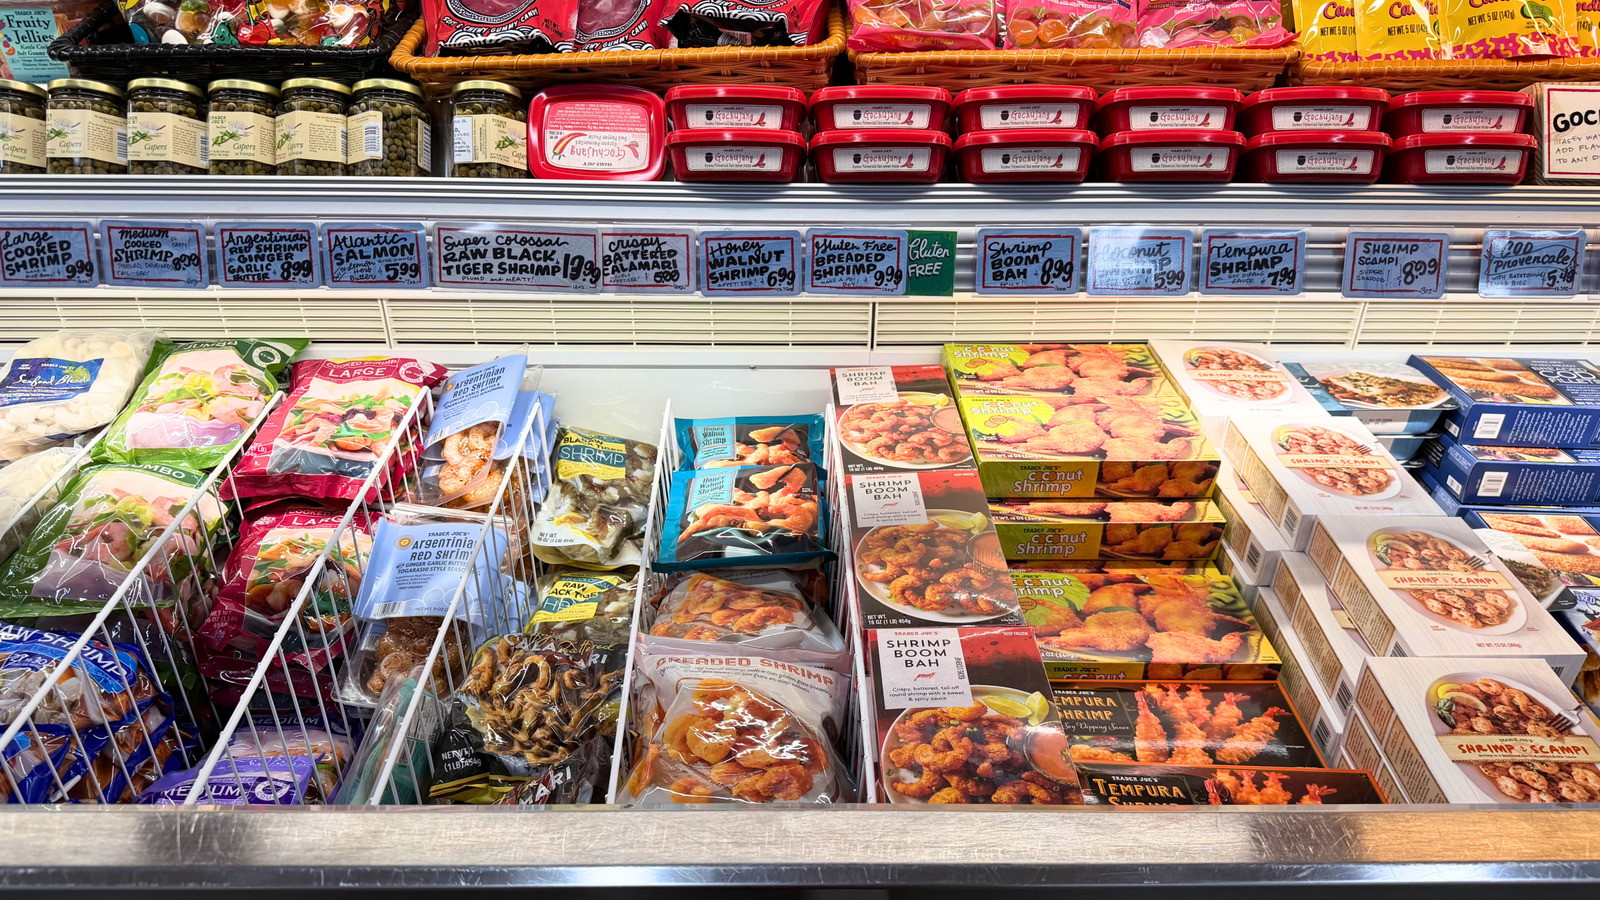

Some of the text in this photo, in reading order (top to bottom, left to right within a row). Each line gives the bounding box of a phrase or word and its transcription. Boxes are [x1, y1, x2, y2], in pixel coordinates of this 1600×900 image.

[1499, 9, 1515, 21] (142g)
[4, 14, 51, 30] Fruity
[491, 20, 519, 34] GUMMY
[12, 30, 55, 44] Jellies
[715, 111, 753, 121] Gochujang
[863, 111, 901, 122] Gochujang
[1011, 110, 1050, 121] Gochujang
[1160, 111, 1199, 122] Gochujang
[1304, 112, 1343, 122] Gochujang
[1453, 114, 1492, 125] Gochujang
[2, 142, 27, 155] Capers
[59, 139, 82, 150] Capers
[143, 141, 167, 152] Capers
[232, 141, 256, 153] Capers
[570, 146, 626, 161] Gochujang
[715, 153, 753, 163] Gochujang
[863, 153, 901, 163] Gochujang
[1012, 153, 1051, 163] Gochujang
[1161, 153, 1201, 164] Gochujang
[1456, 155, 1495, 165] Gochujang
[1571, 156, 1588, 164] ANY
[1307, 155, 1346, 166] Gochujang
[2, 231, 53, 250] Large
[124, 240, 162, 249] COOKED
[222, 231, 311, 250] Argentinian
[329, 232, 407, 252] Atlantic
[443, 236, 569, 251] Super Colossal
[608, 235, 667, 253] Crispy
[4, 240, 71, 262] COOKED
[229, 243, 307, 255] RED SHRIMP
[709, 241, 765, 259] Honey
[815, 239, 897, 256] Gluten Free
[908, 238, 950, 261] Gluten
[988, 241, 1052, 260] Shrimp
[1210, 243, 1293, 260] Tempura
[1362, 242, 1419, 255] SHRIMP
[114, 249, 173, 263] SHRIMP
[237, 253, 294, 264] GINGER
[333, 243, 415, 267] SALMON
[443, 247, 556, 263] RAW BLACK
[603, 249, 678, 267] BATTERED
[709, 250, 784, 270] WALNUT
[815, 252, 885, 267] BREADED
[1357, 256, 1398, 266] SCAMPI
[6, 252, 72, 276] SHRIMP
[228, 263, 272, 274] GARLIC
[603, 259, 677, 276] CALAMARI
[991, 254, 1039, 270] BOOM
[1210, 255, 1283, 277] SHRIMP
[442, 262, 494, 276] TIGER
[497, 262, 562, 276] SHRIMP
[709, 266, 769, 284] SHRIMP
[813, 263, 877, 281] SHRIMP
[908, 262, 943, 278] FREE
[992, 268, 1027, 281] BAH
[232, 272, 270, 281] BUTTER
[326, 361, 361, 369] COOKED
[328, 367, 387, 378] LARGE
[455, 367, 505, 389] Argentinian
[1539, 370, 1597, 380] COD
[12, 373, 88, 387] Seafood Blend
[560, 446, 624, 465] SHRIMP
[859, 480, 911, 489] SHRIMP
[865, 487, 908, 495] BOOM
[1014, 481, 1073, 494] Shrimp
[873, 493, 902, 501] BAH
[1017, 543, 1076, 557] Shrimp
[1393, 576, 1498, 585] SHRIMP SCAMPI
[886, 639, 952, 648] SHRIMP
[894, 649, 948, 658] BOOM
[904, 659, 940, 667] BAH
[656, 657, 835, 686] BREADED SHRIMP
[1053, 696, 1118, 707] EMPURA
[1064, 722, 1130, 733] Soy Dipping Sauce
[1457, 744, 1515, 754] SHRIMP
[1529, 744, 1589, 756] SCAMPI
[1092, 778, 1186, 798] TEMPURA
